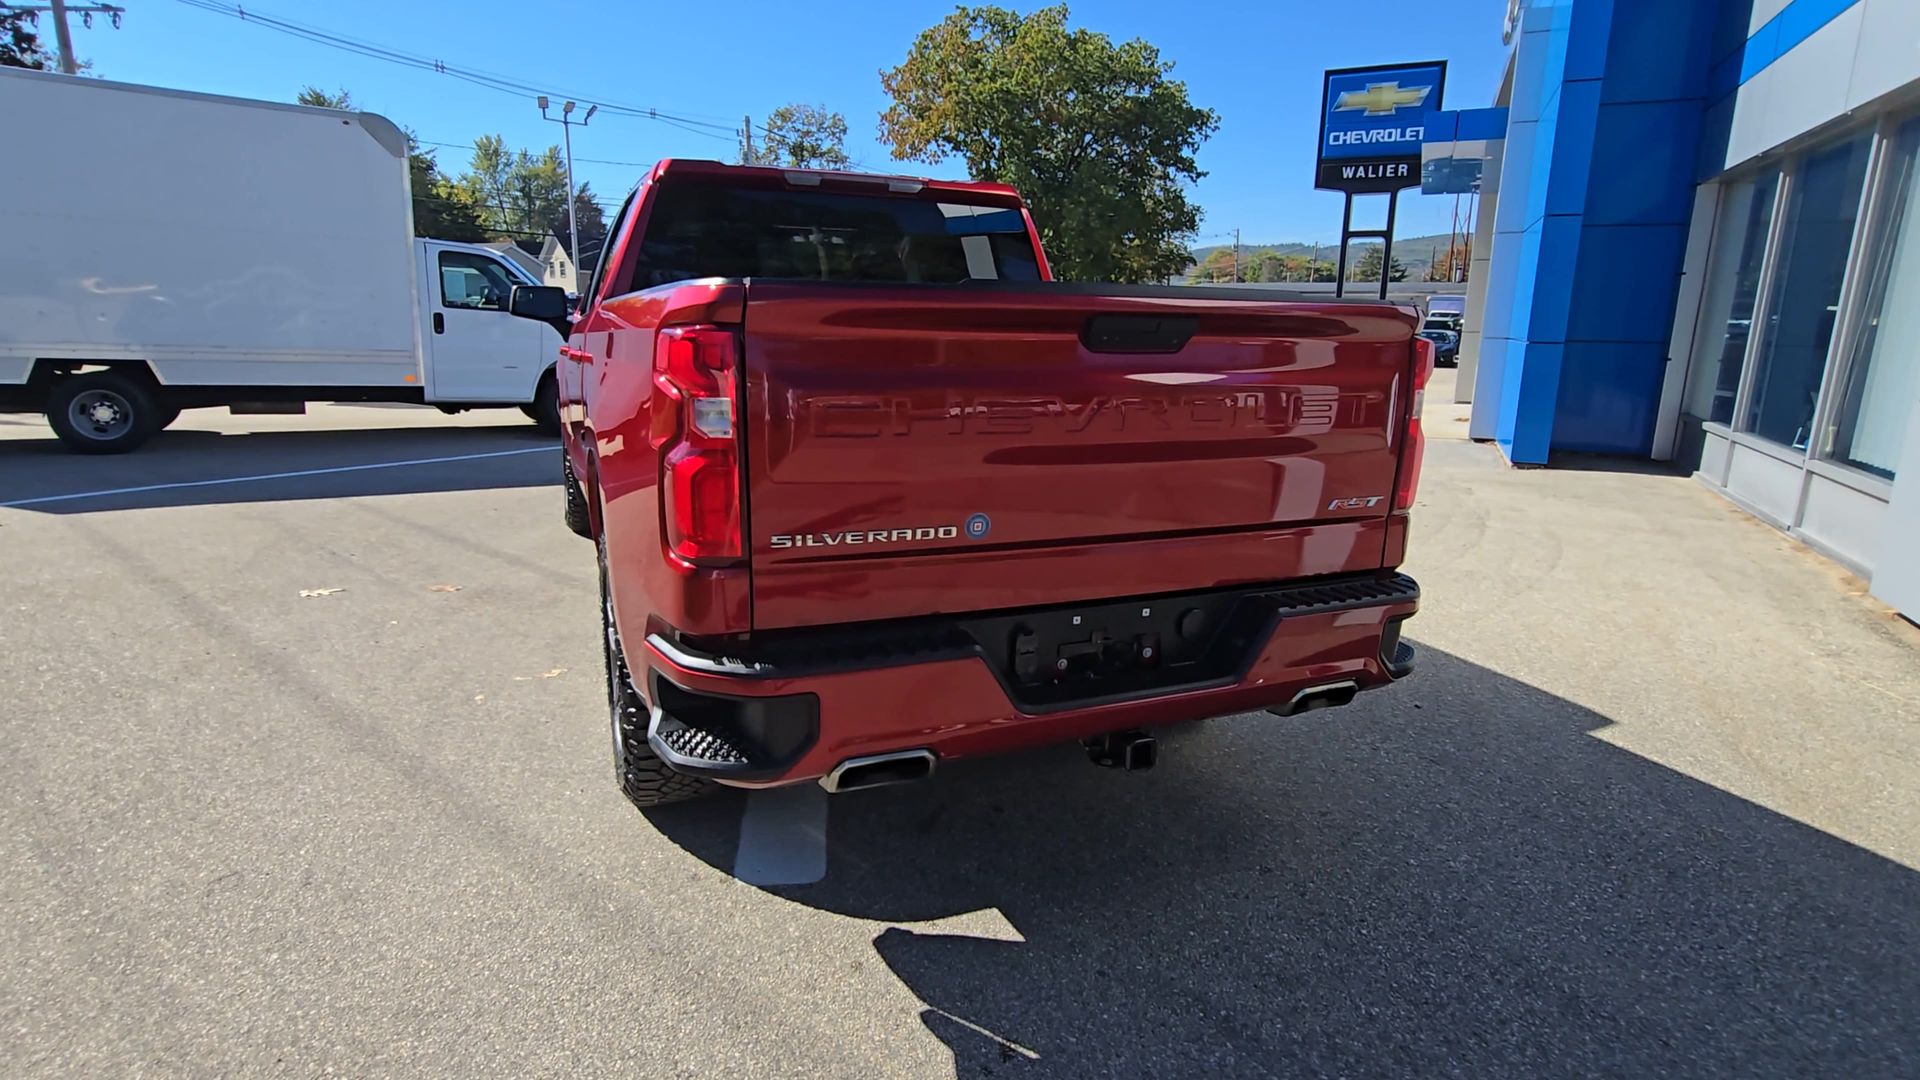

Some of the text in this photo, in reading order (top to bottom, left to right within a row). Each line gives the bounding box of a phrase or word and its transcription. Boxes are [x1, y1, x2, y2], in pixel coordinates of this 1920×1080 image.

[1329, 127, 1424, 145] CHEVROLET
[1342, 164, 1408, 179] WALIER
[1327, 496, 1384, 511] RST
[770, 526, 957, 548] SILVERADO
